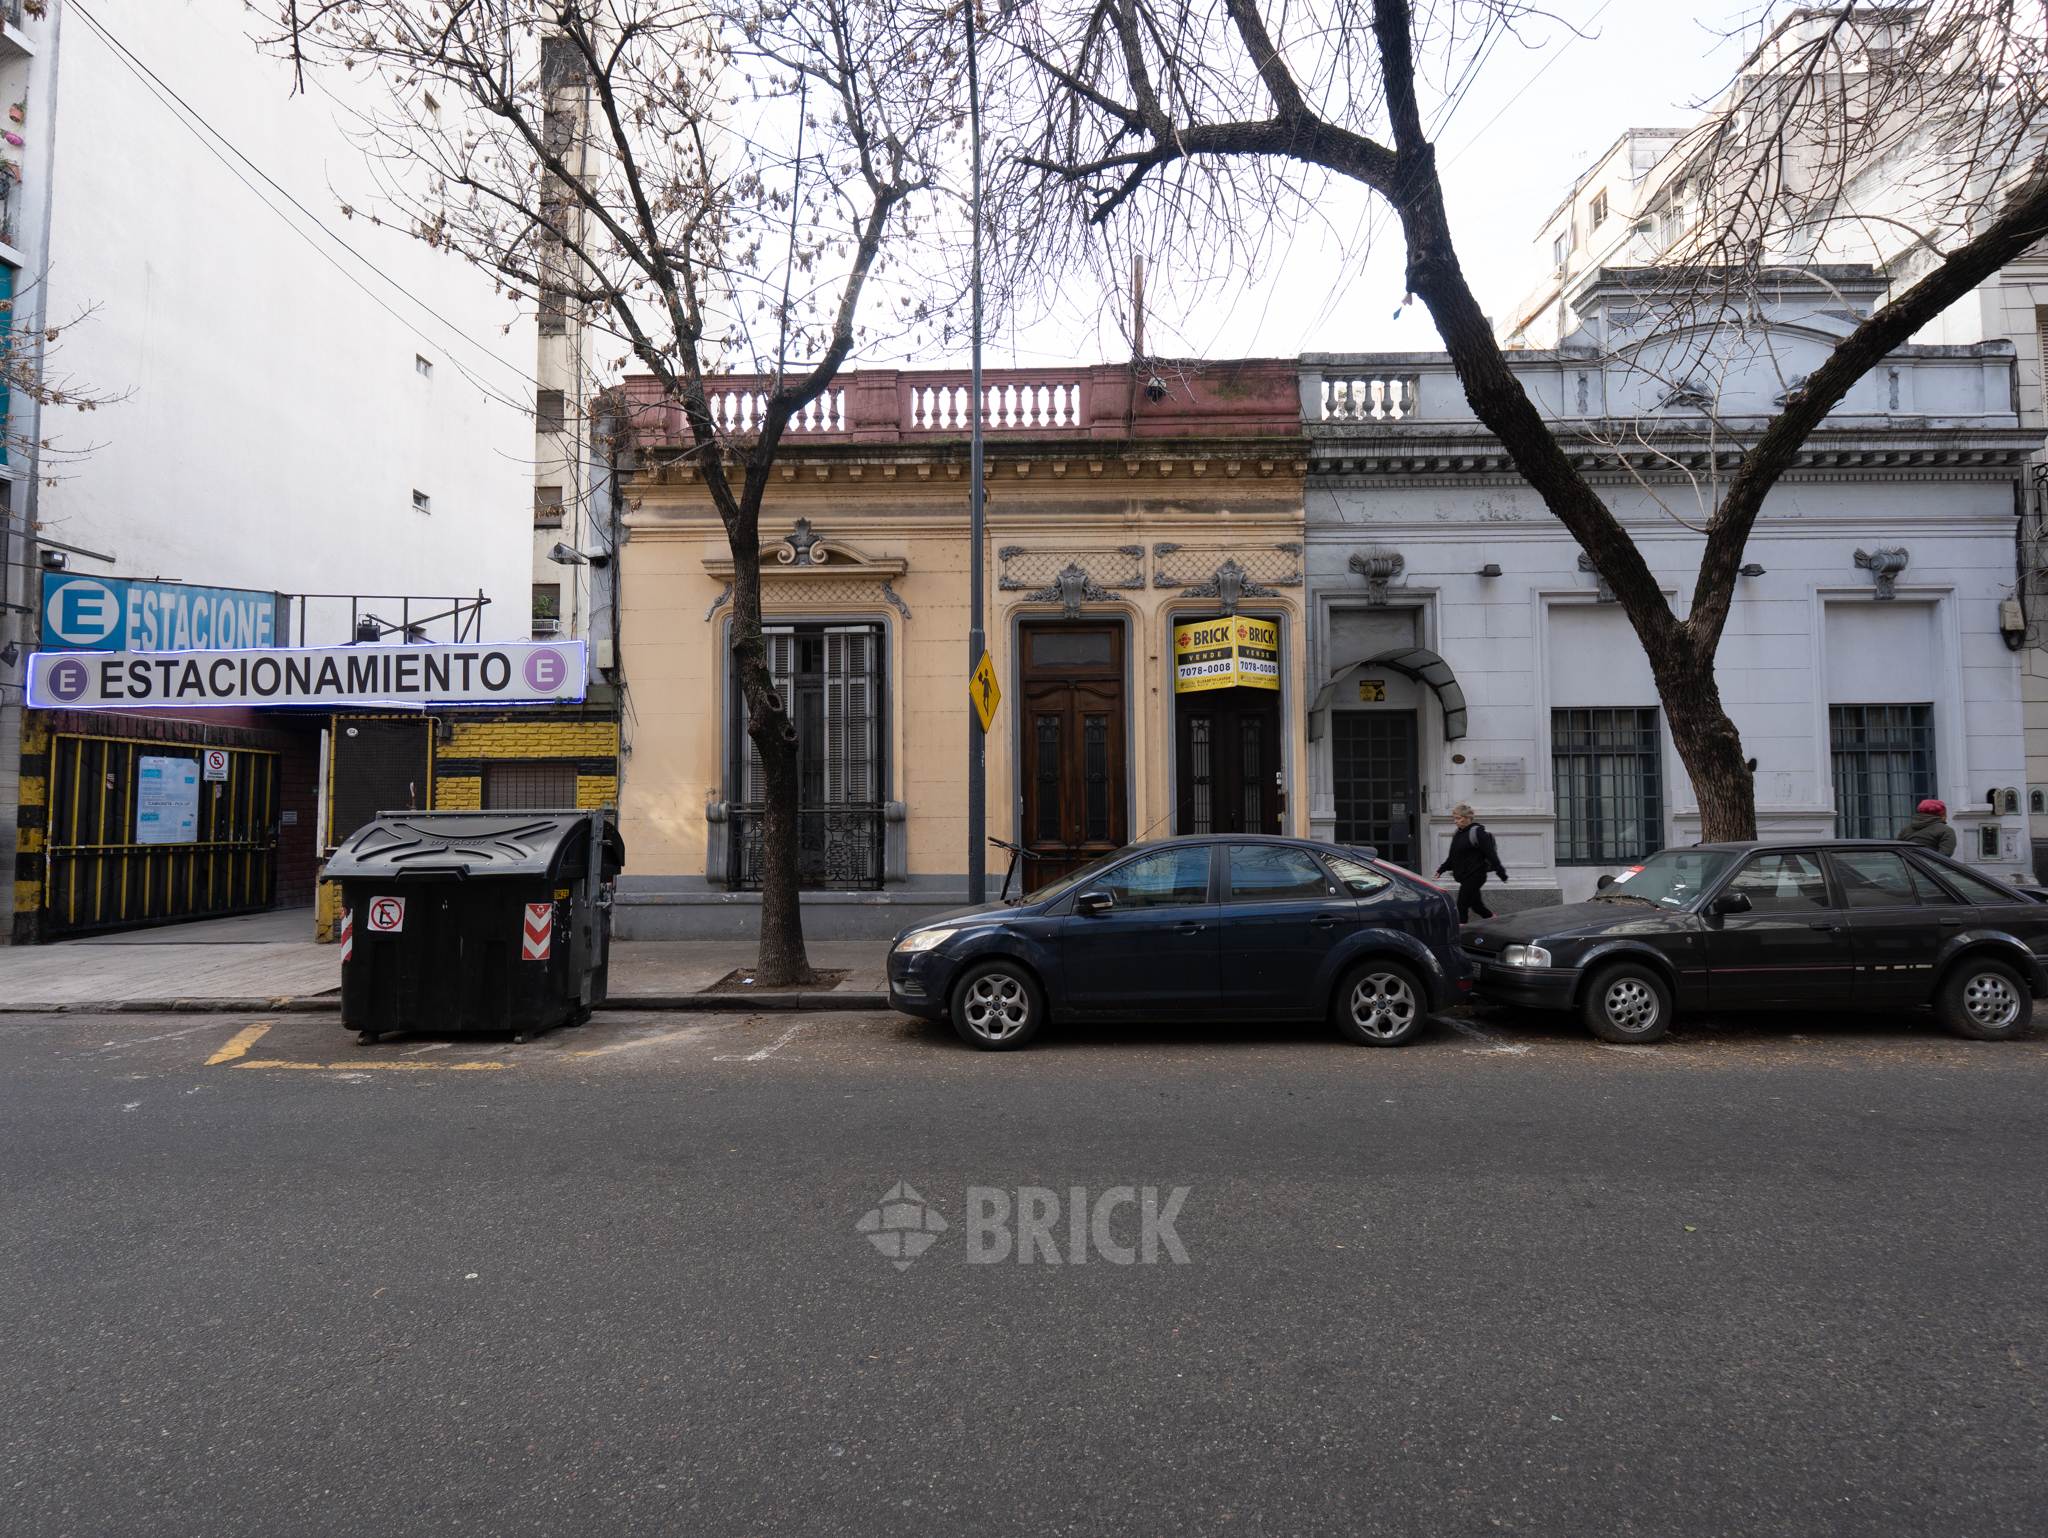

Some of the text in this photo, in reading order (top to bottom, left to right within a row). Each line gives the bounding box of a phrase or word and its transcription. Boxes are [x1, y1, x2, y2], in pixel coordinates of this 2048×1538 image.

[61, 588, 273, 650] E ESTACIONE
[1193, 626, 1229, 645] BRICK
[1249, 626, 1274, 644] BRICK
[1189, 651, 1222, 661] VENDE
[1246, 649, 1270, 659] VENDE
[59, 651, 555, 698] E ESTACIONAMIENTO E
[1180, 662, 1231, 678] 7078-0008
[1240, 661, 1277, 674] 7078-0008
